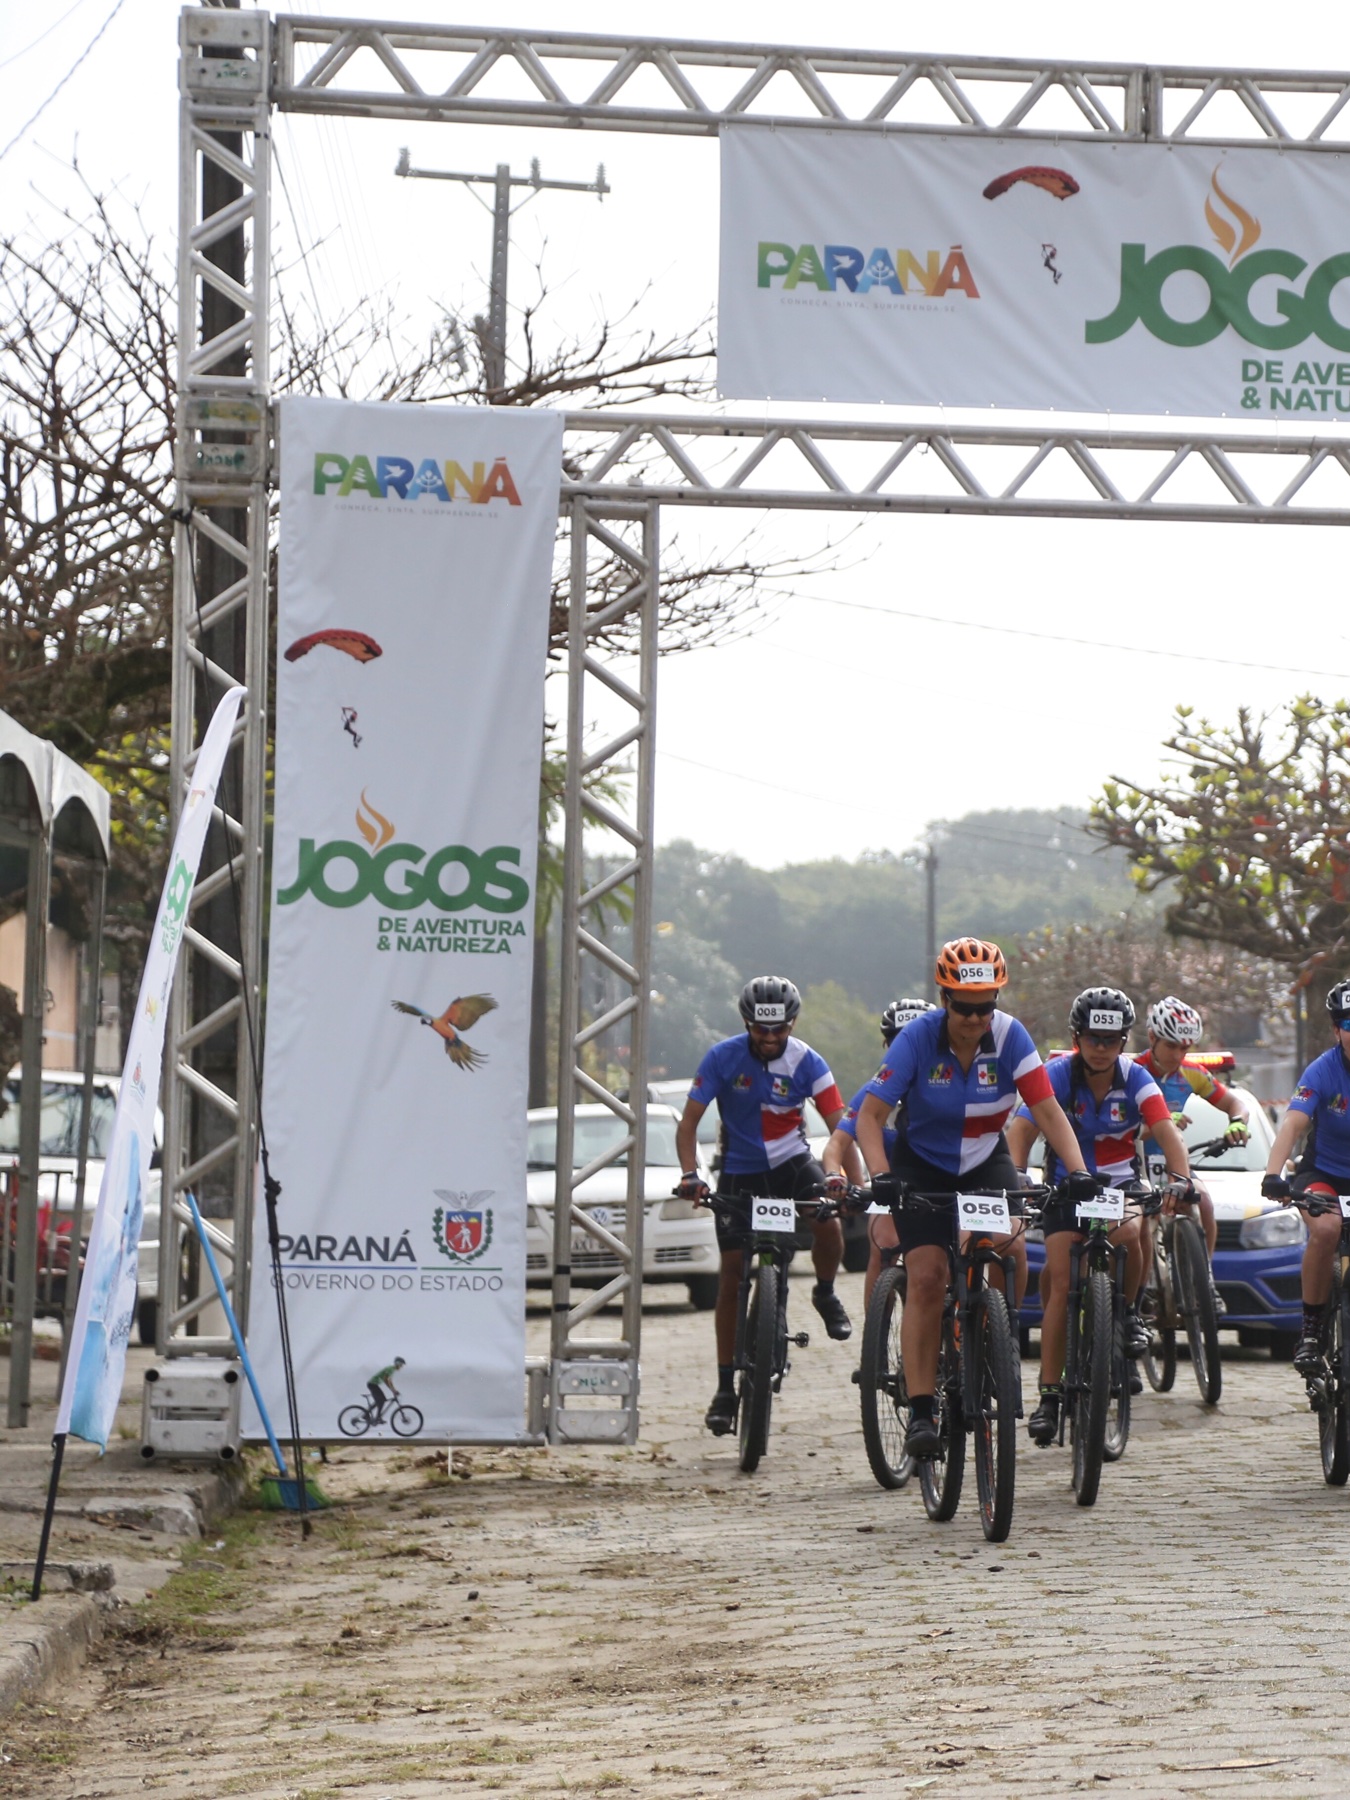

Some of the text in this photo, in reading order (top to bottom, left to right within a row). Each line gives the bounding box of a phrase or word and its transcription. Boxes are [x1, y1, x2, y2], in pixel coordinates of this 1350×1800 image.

[757, 241, 981, 299] PARANÁ
[1241, 359, 1284, 384] DE
[1240, 386, 1262, 410] &
[313, 452, 522, 507] PARANÁ
[277, 838, 530, 914] JOGOS
[378, 916, 526, 937] DE AVENTURA
[376, 934, 512, 955] & NATUREZA
[961, 967, 983, 978] 056
[757, 1007, 777, 1016] 008
[1093, 1013, 1114, 1024] 053
[962, 1202, 1005, 1216] 056
[1095, 1193, 1120, 1205] 53
[756, 1205, 792, 1217] 008
[271, 1229, 417, 1262] PARANÁ
[270, 1273, 503, 1291] GOVERNO DO ESTADO
